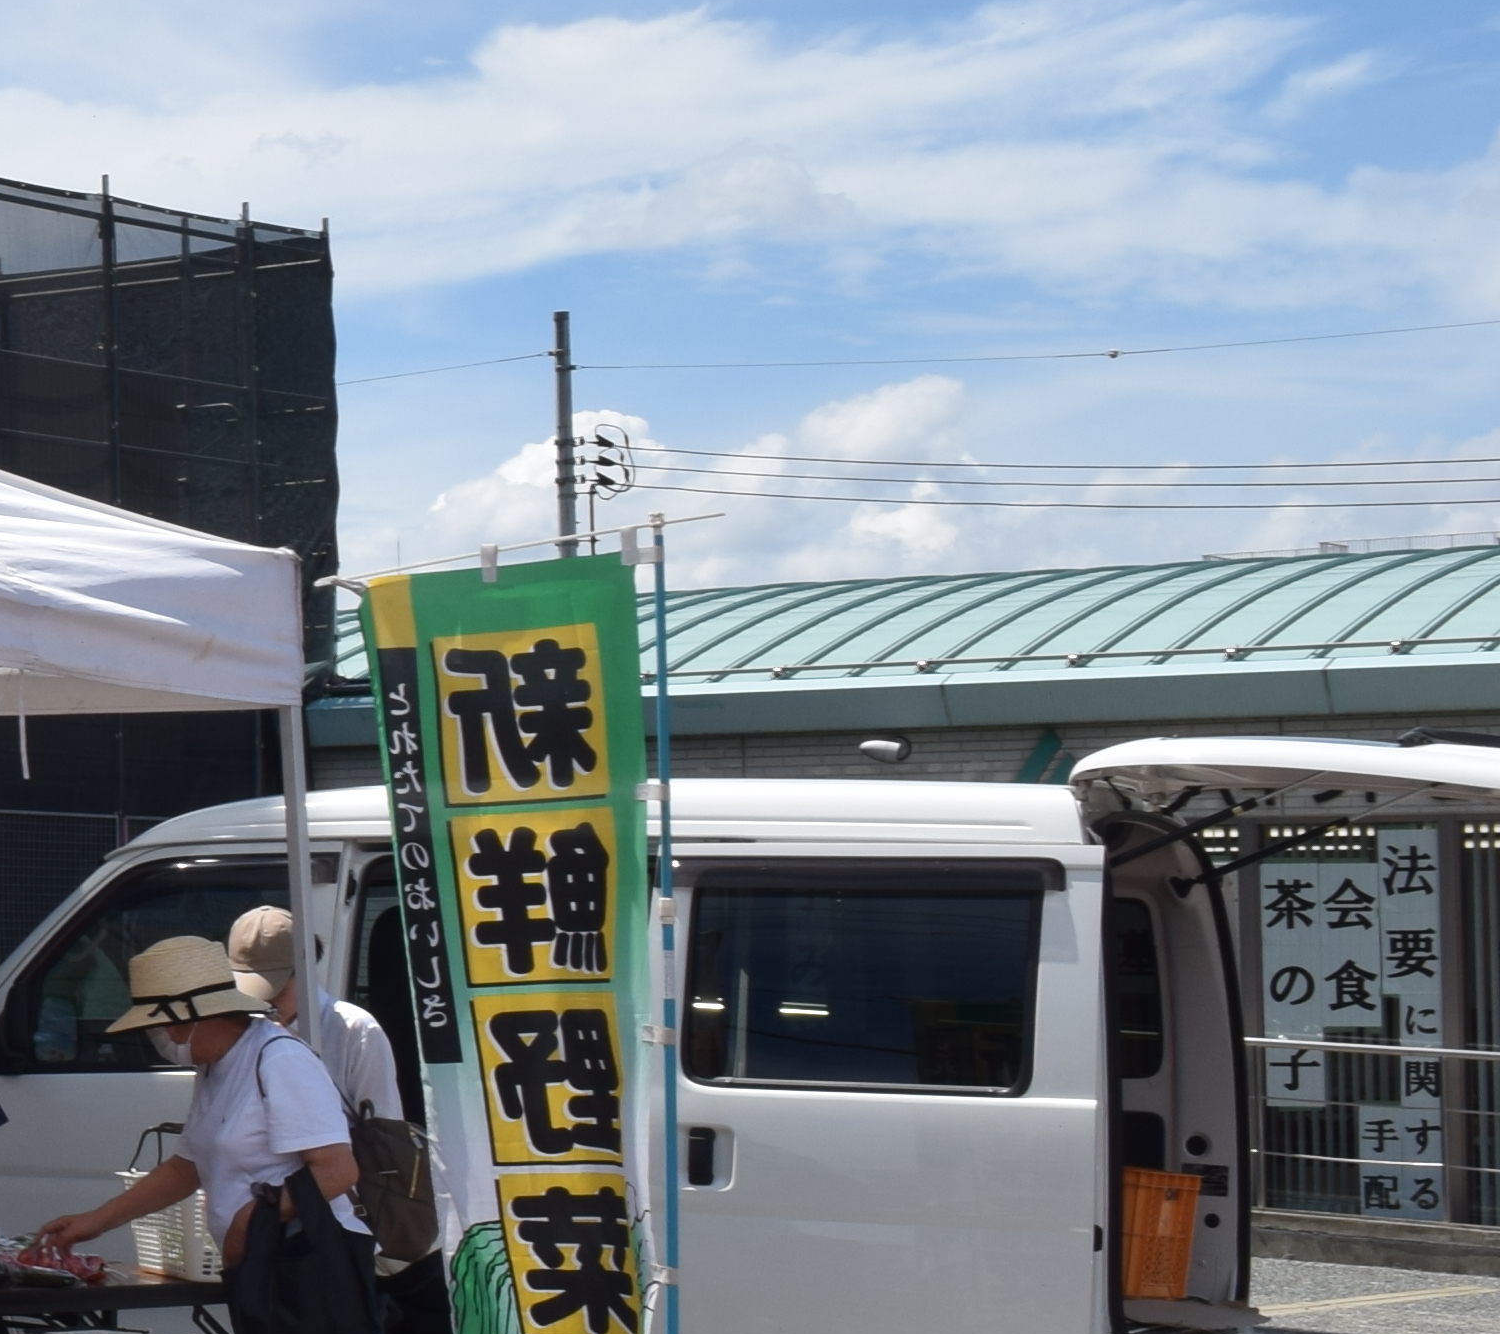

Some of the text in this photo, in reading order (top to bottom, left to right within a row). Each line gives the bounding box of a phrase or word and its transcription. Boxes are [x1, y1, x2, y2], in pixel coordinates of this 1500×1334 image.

[1263, 879, 1320, 1091] 茶の子
[1323, 878, 1377, 1012] 会食
[1382, 846, 1441, 1209] 法要に関する
[1362, 1119, 1399, 1209] 手配
